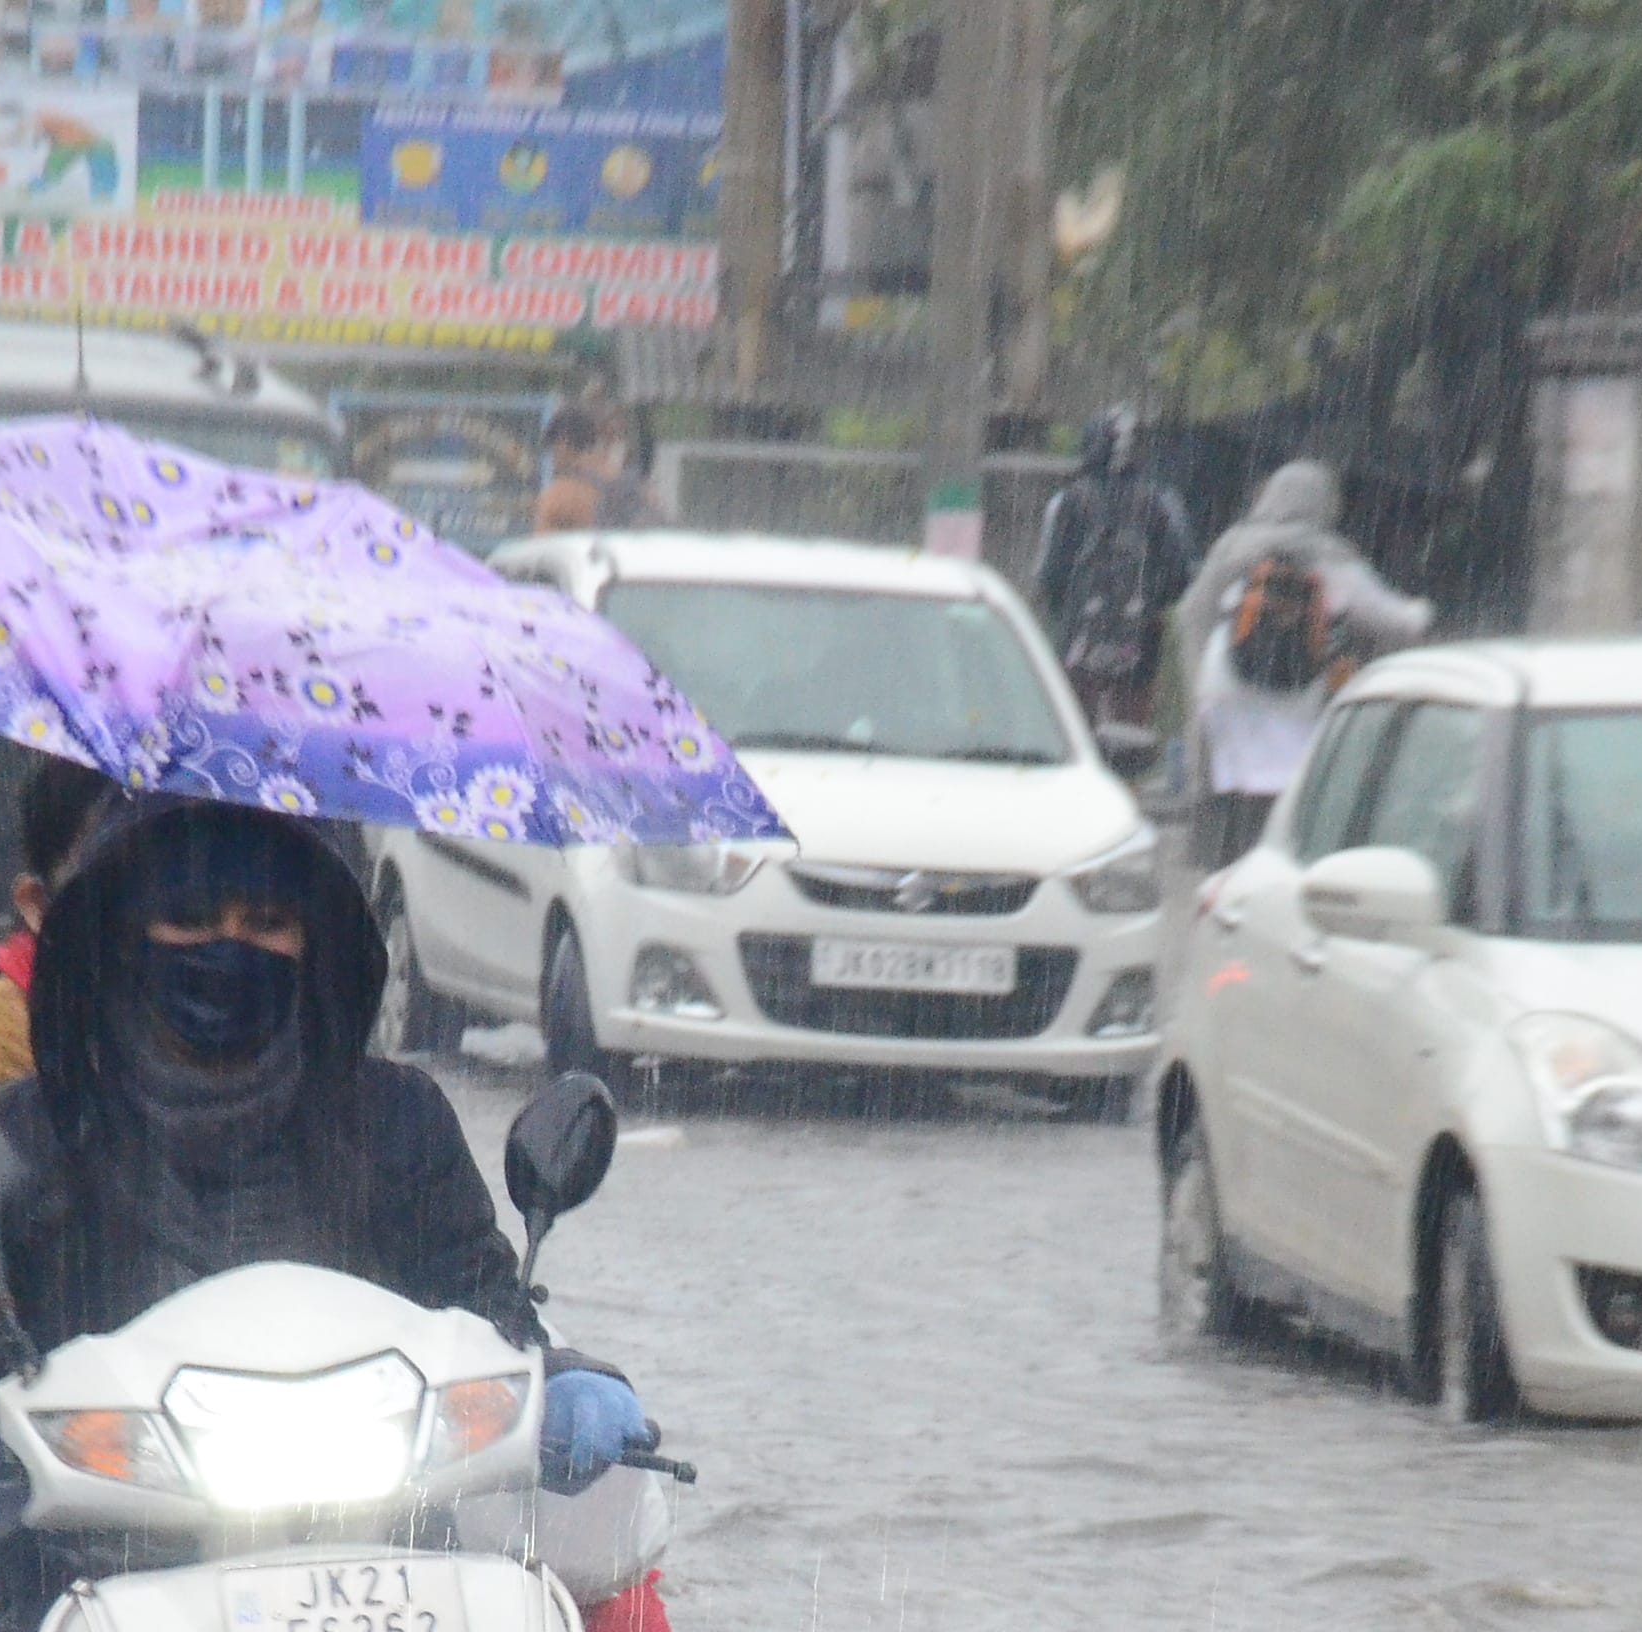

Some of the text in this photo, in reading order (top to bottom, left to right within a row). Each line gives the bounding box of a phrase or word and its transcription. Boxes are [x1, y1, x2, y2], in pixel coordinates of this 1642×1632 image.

[69, 218, 271, 266] SHAHEED
[289, 227, 491, 274] WELFARE
[85, 267, 262, 311] STADIUM
[276, 274, 305, 313] &
[317, 277, 393, 318] DPL
[406, 281, 586, 327] GROUND
[298, 1563, 413, 1611] JK21
